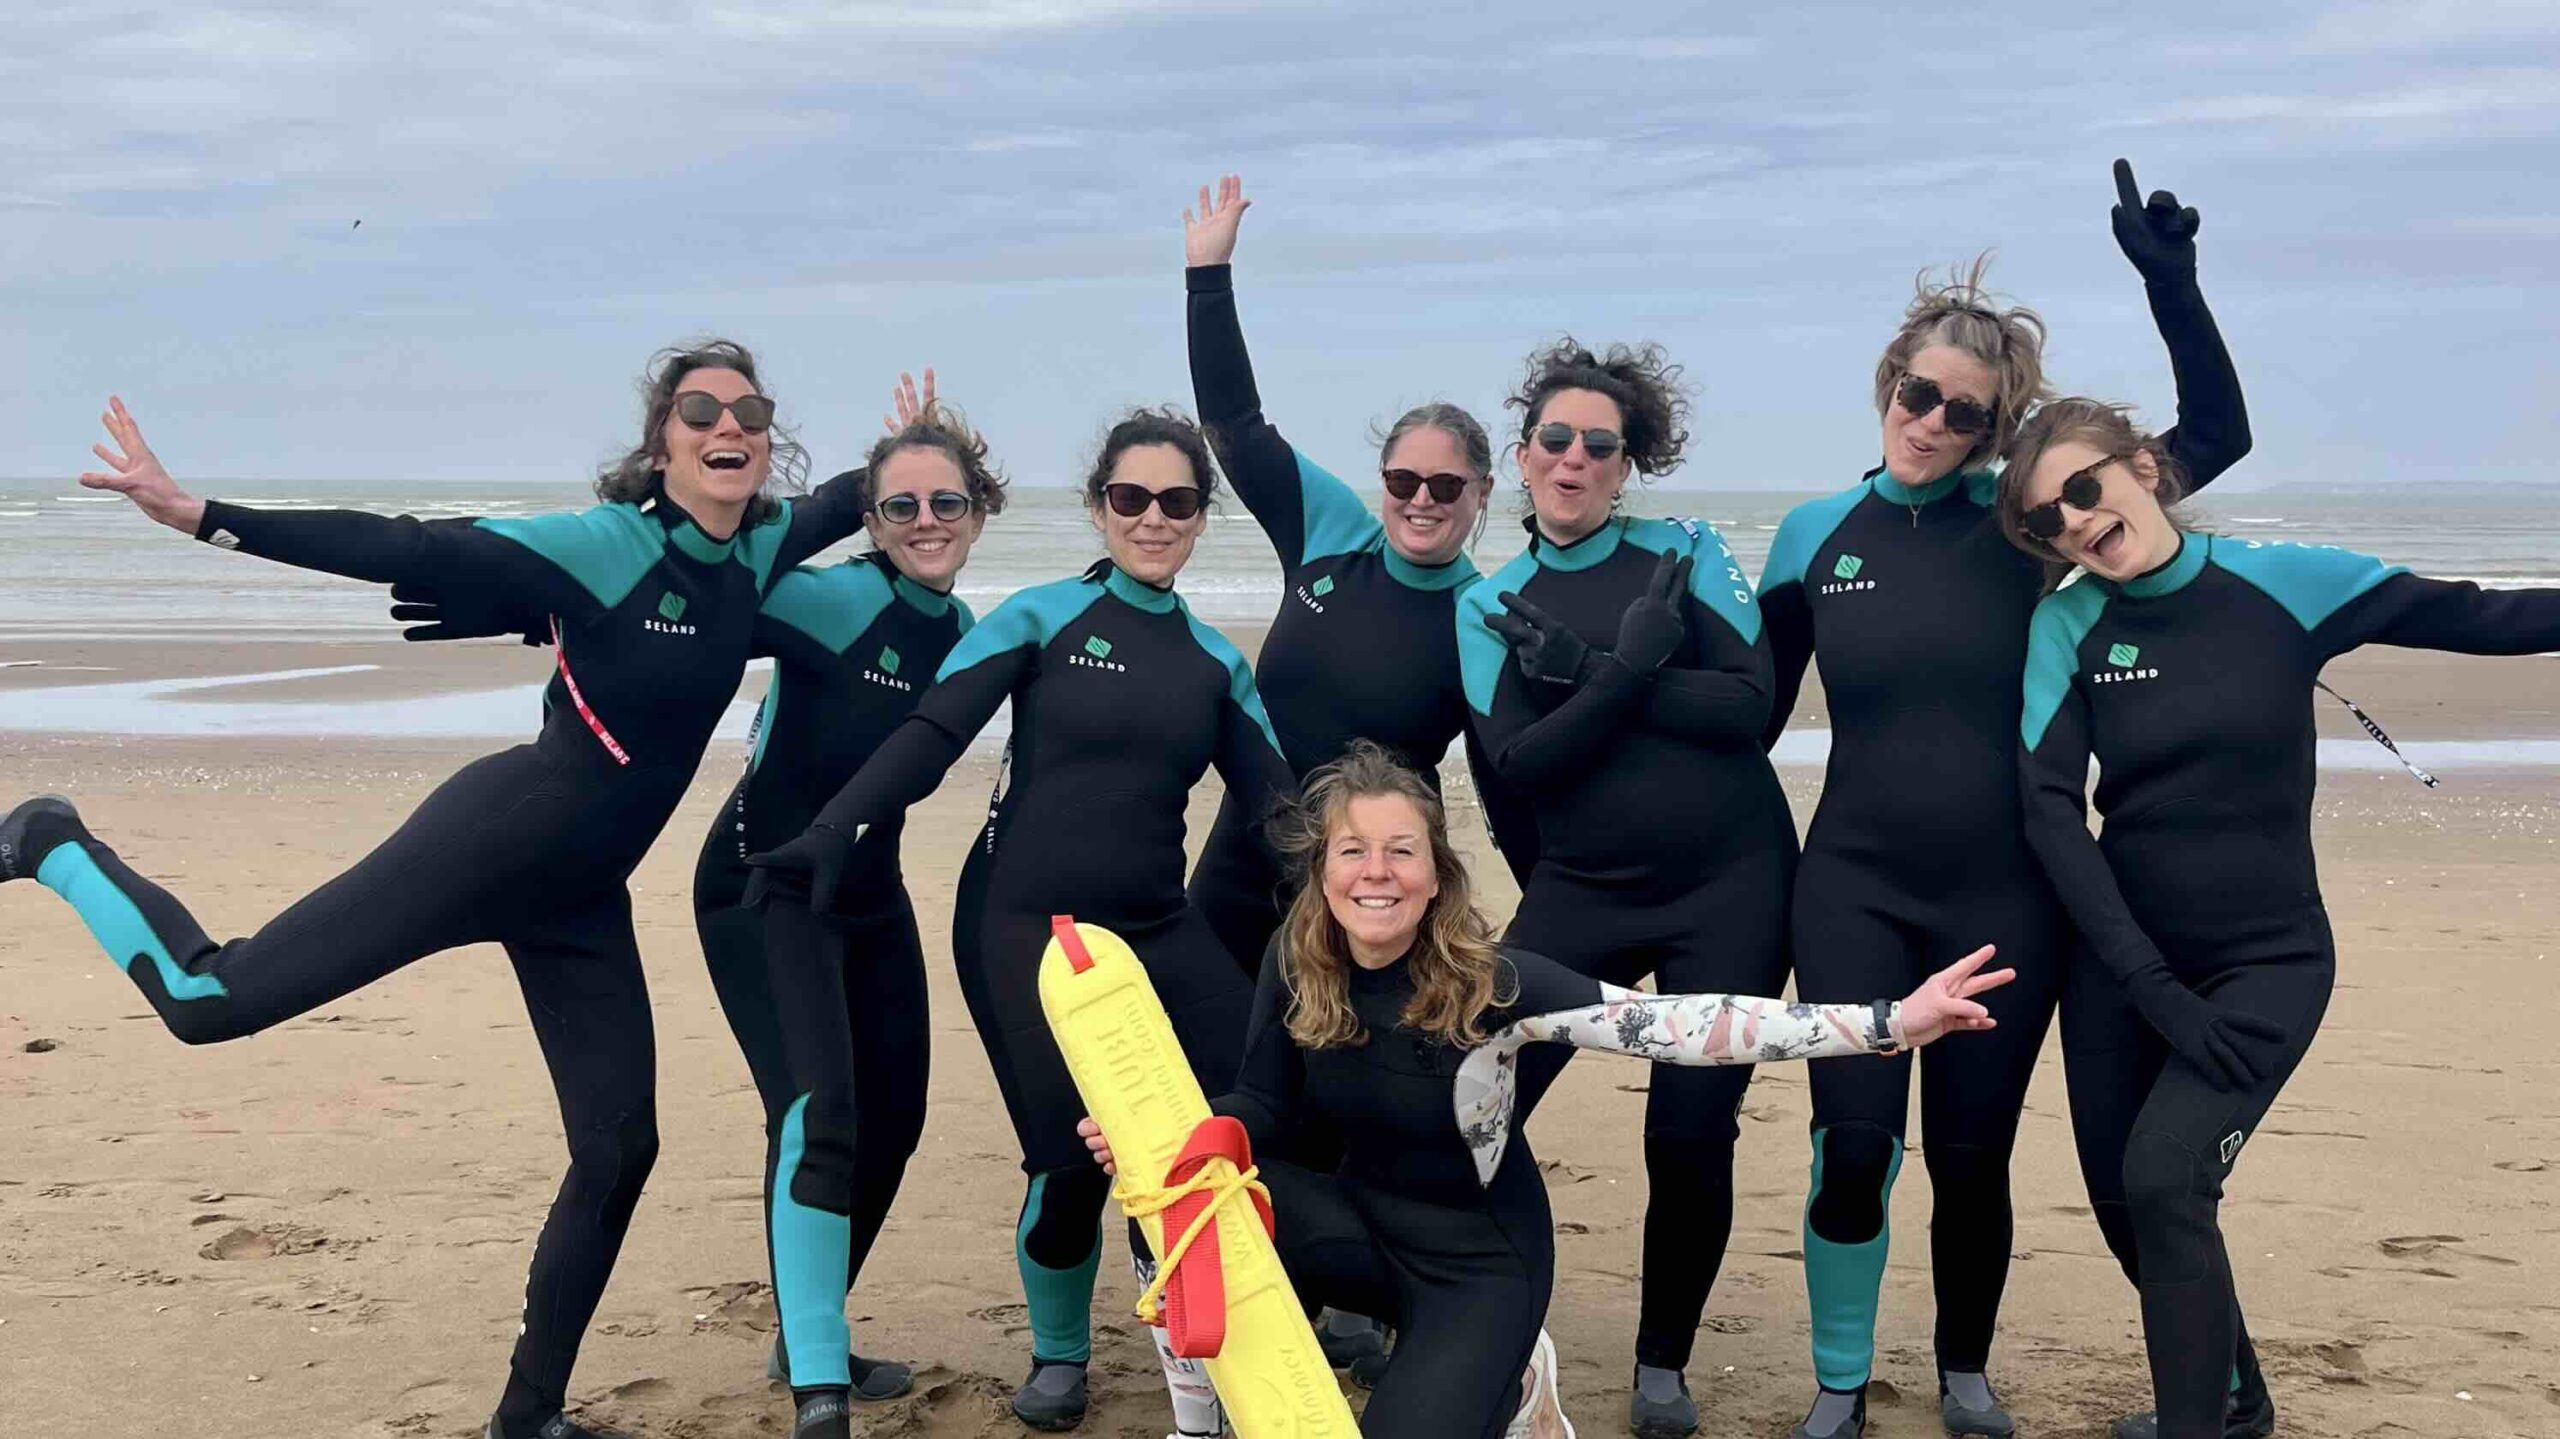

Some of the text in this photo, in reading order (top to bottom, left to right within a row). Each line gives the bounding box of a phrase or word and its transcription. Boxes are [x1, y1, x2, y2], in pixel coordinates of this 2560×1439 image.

[1821, 580, 1876, 595] SELAND
[1296, 585, 1324, 614] SELAND
[644, 619, 697, 635] SELAND
[1069, 654, 1126, 673] SELAND
[864, 670, 911, 691] SELAND
[2093, 668, 2159, 684] SELAND
